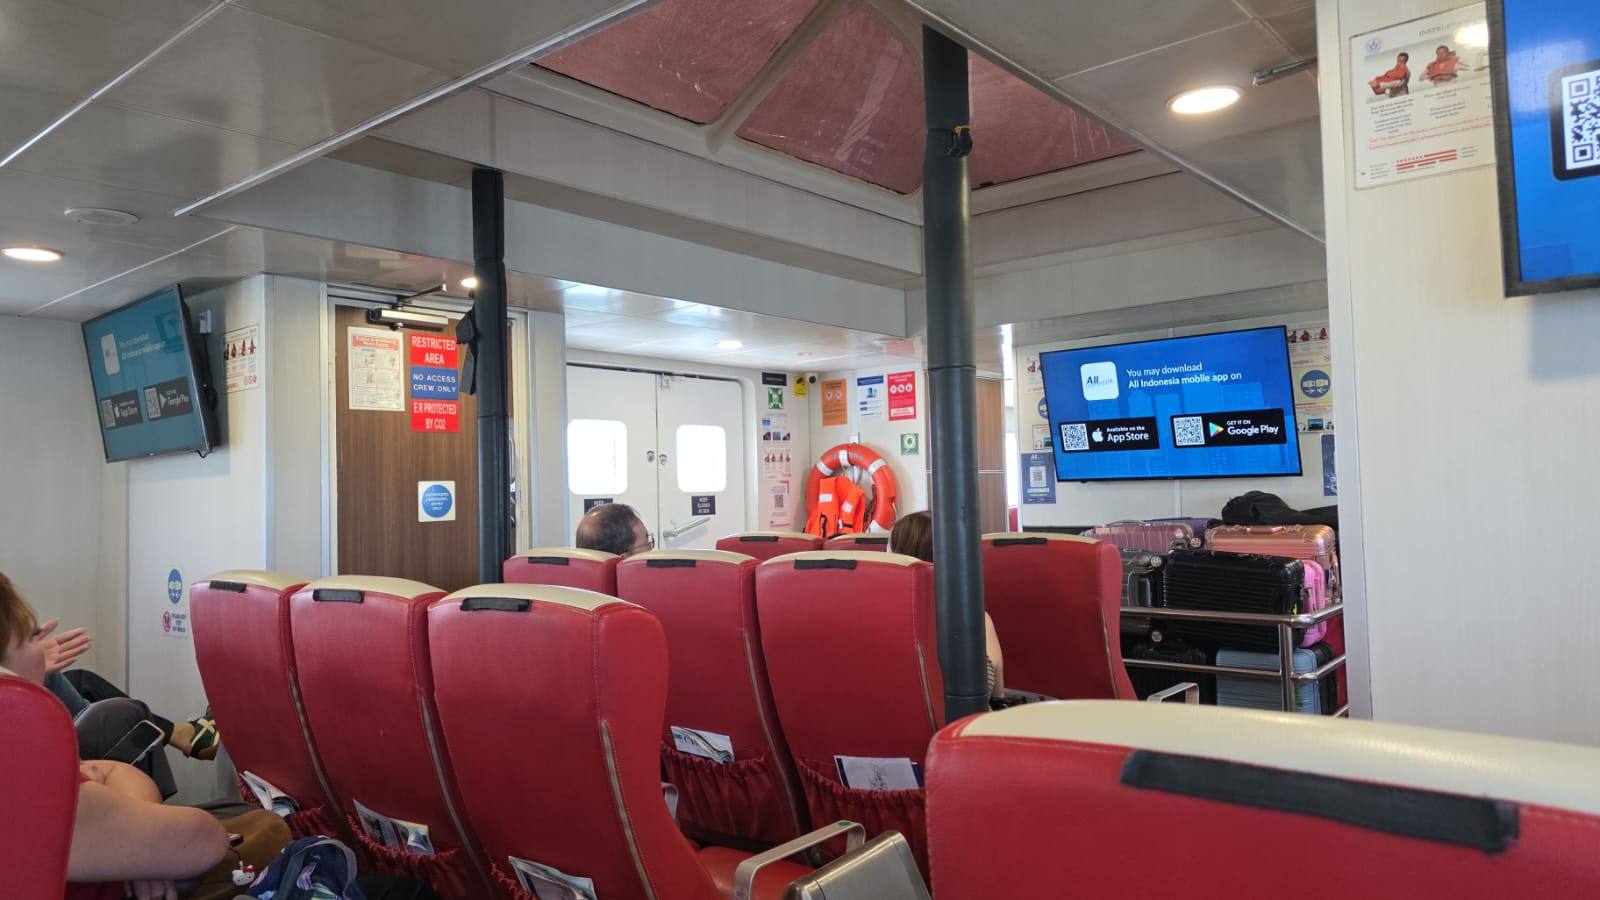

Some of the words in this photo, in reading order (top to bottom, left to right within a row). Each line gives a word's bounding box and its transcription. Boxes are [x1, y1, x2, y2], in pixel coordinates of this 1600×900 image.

[411, 335, 456, 351] RESTRICTED
[424, 352, 445, 365] AREA
[1126, 369, 1141, 377] You
[1143, 368, 1160, 377] may
[1162, 362, 1202, 375] download
[413, 373, 423, 381] NO
[427, 374, 456, 383] ACCESS
[1086, 375, 1099, 385] All
[1128, 380, 1139, 389] All
[1141, 377, 1180, 387] Indonesia
[1181, 373, 1210, 384] mobile
[1212, 374, 1228, 383] app
[1230, 372, 1242, 380] on
[413, 383, 434, 391] CREW
[437, 385, 456, 393] ONLY
[424, 402, 456, 415] PROTECTED
[425, 418, 433, 429] BY
[1227, 425, 1259, 436] Google
[1260, 424, 1279, 435] Play
[1107, 433, 1125, 443] App
[1125, 432, 1149, 441] Store
